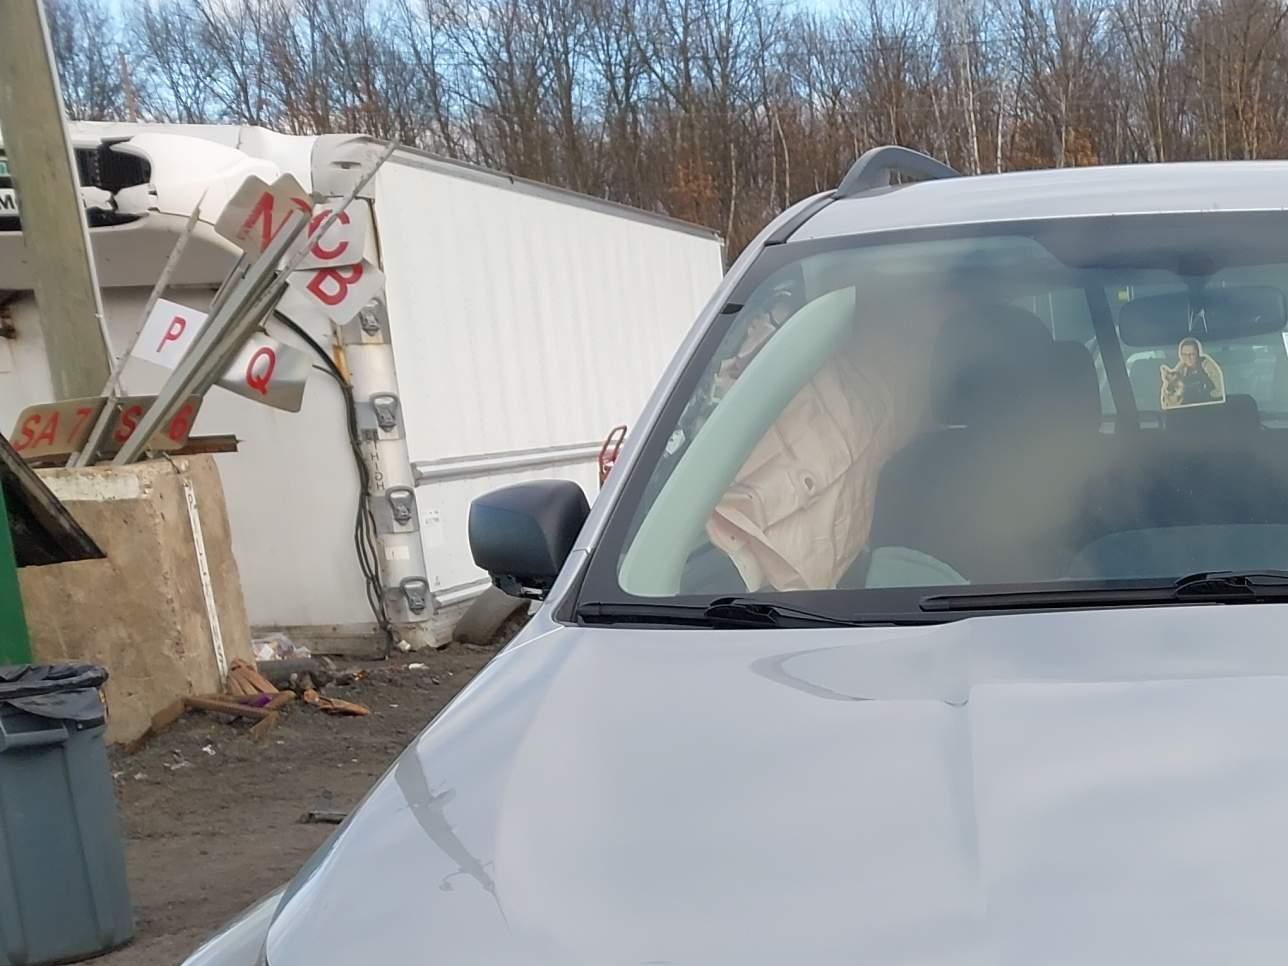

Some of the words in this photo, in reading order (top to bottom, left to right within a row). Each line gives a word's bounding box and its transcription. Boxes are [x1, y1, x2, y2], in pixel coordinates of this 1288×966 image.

[308, 209, 350, 260] C
[306, 263, 363, 305] B
[156, 316, 186, 353] P
[246, 347, 276, 395] Q
